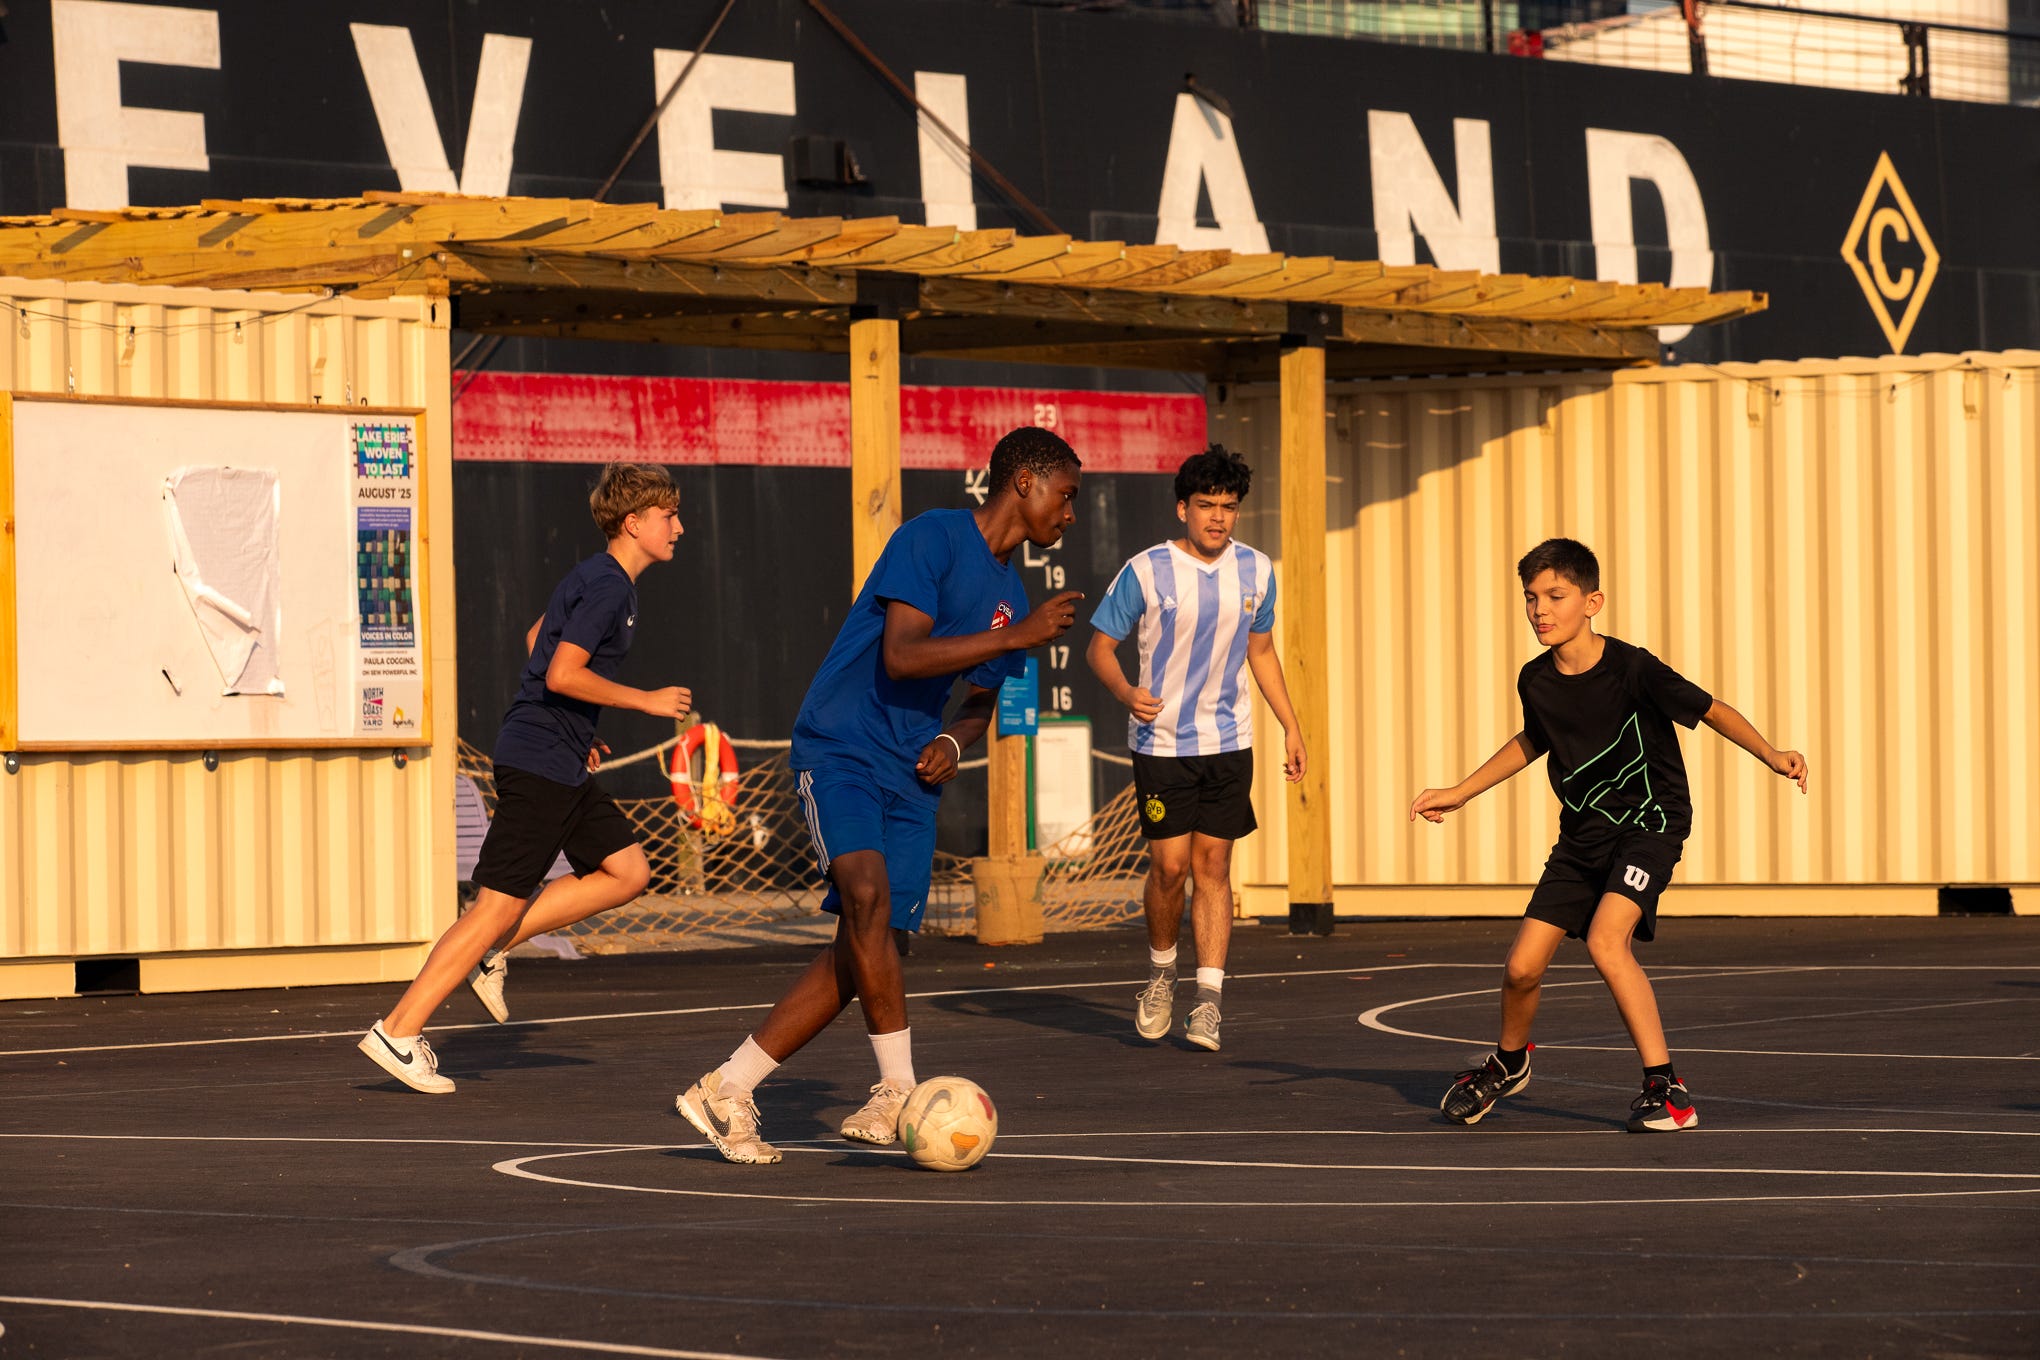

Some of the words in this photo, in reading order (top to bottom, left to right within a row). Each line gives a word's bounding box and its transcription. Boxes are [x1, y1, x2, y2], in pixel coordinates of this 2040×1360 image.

[1868, 207, 1914, 301] C
[1034, 404, 1057, 428] 23
[357, 431, 382, 442] LAKE
[364, 447, 402, 459] WOVEN
[364, 463, 378, 474] TO
[380, 463, 404, 475] LAST
[358, 488, 396, 498] AUGUST
[398, 488, 411, 499] '25
[1045, 565, 1065, 589] 19
[362, 631, 384, 640] VOICES
[385, 632, 391, 640] IN
[392, 632, 413, 640] COLOR
[363, 657, 385, 665] PAULA
[1050, 645, 1070, 669] 17
[363, 688, 384, 701] NORTH
[1052, 686, 1072, 711] 16
[363, 703, 383, 715] COAST
[1147, 803, 1162, 814] BVB
